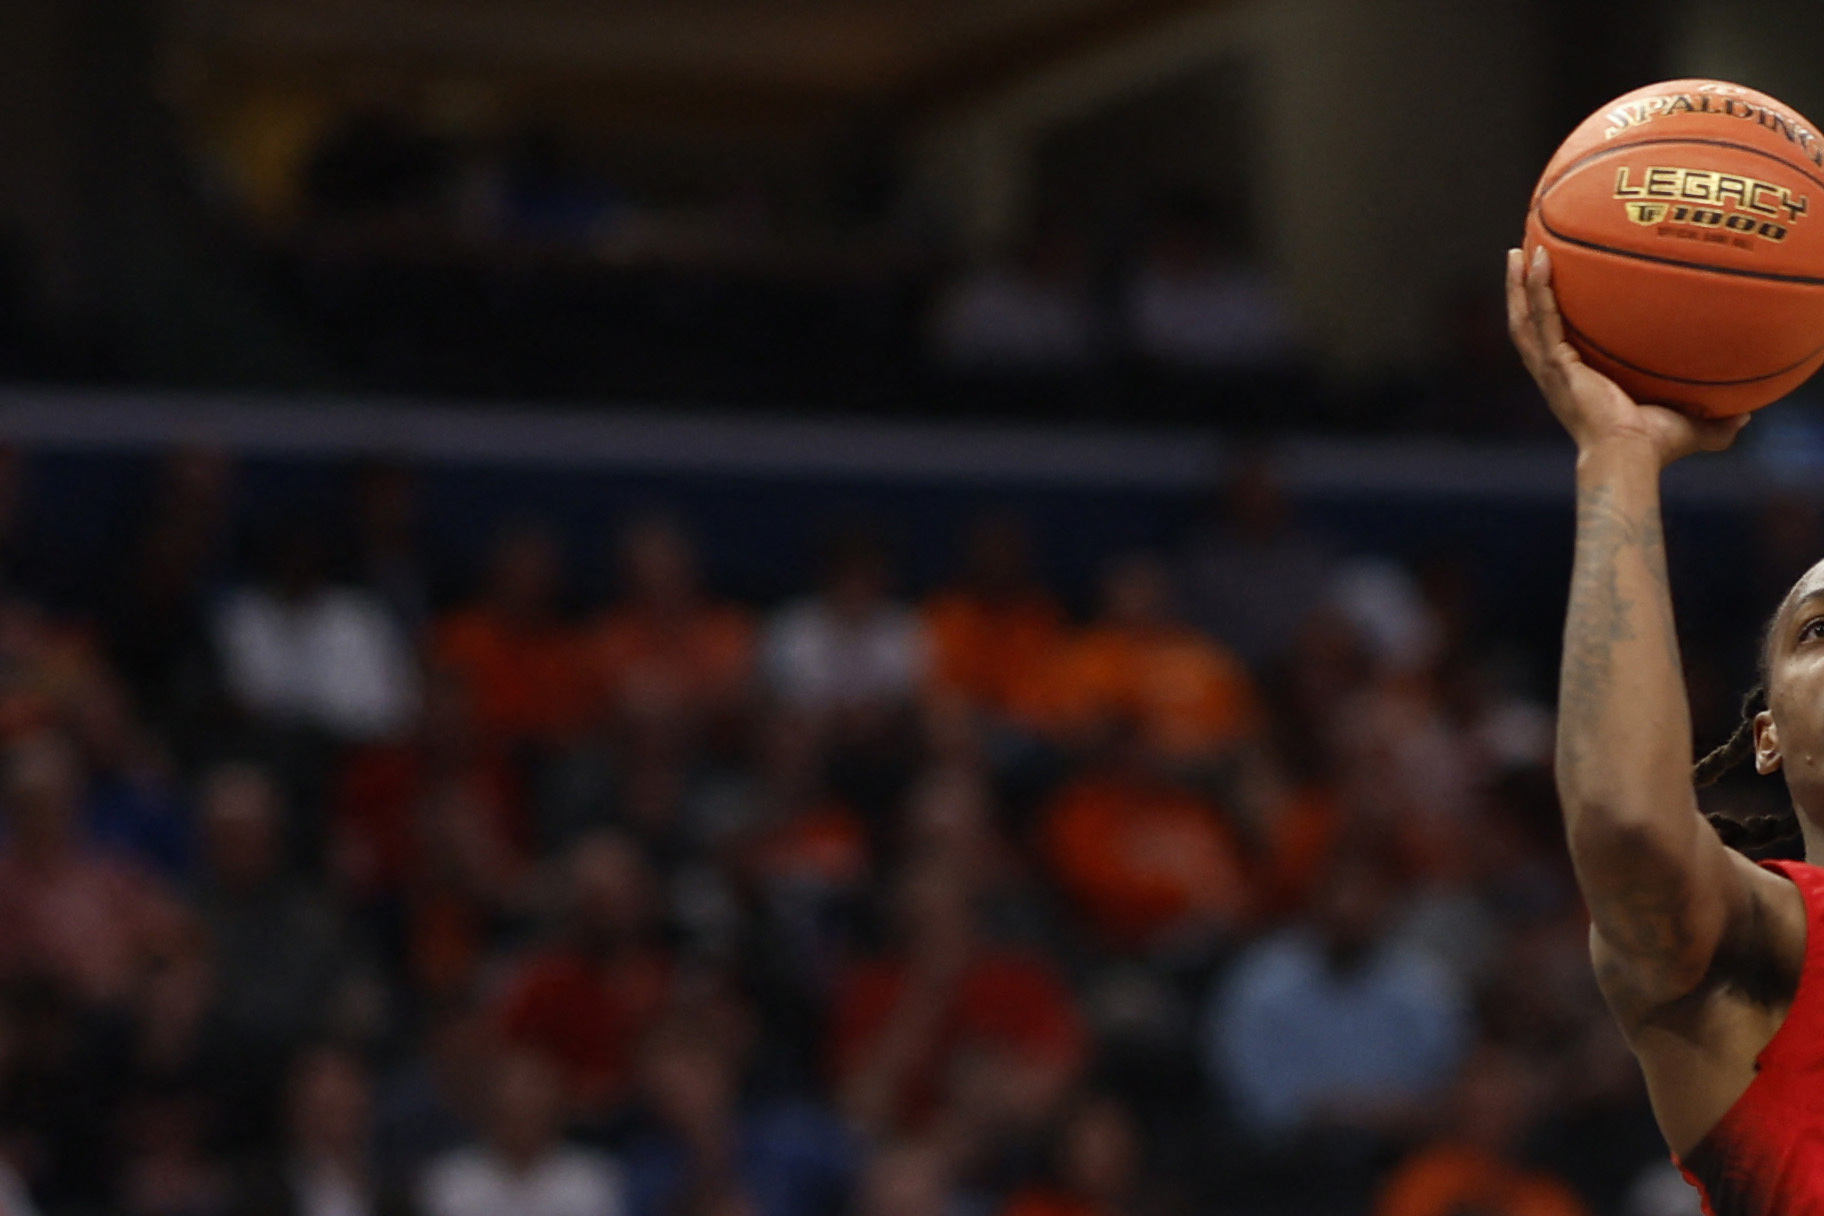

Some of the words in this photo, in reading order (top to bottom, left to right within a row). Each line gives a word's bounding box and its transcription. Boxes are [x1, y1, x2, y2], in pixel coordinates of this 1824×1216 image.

[1604, 93, 1824, 167] SPALDING
[1613, 166, 1808, 225] LEGACY
[1627, 203, 1668, 225] TF
[1670, 205, 1787, 243] 1000
